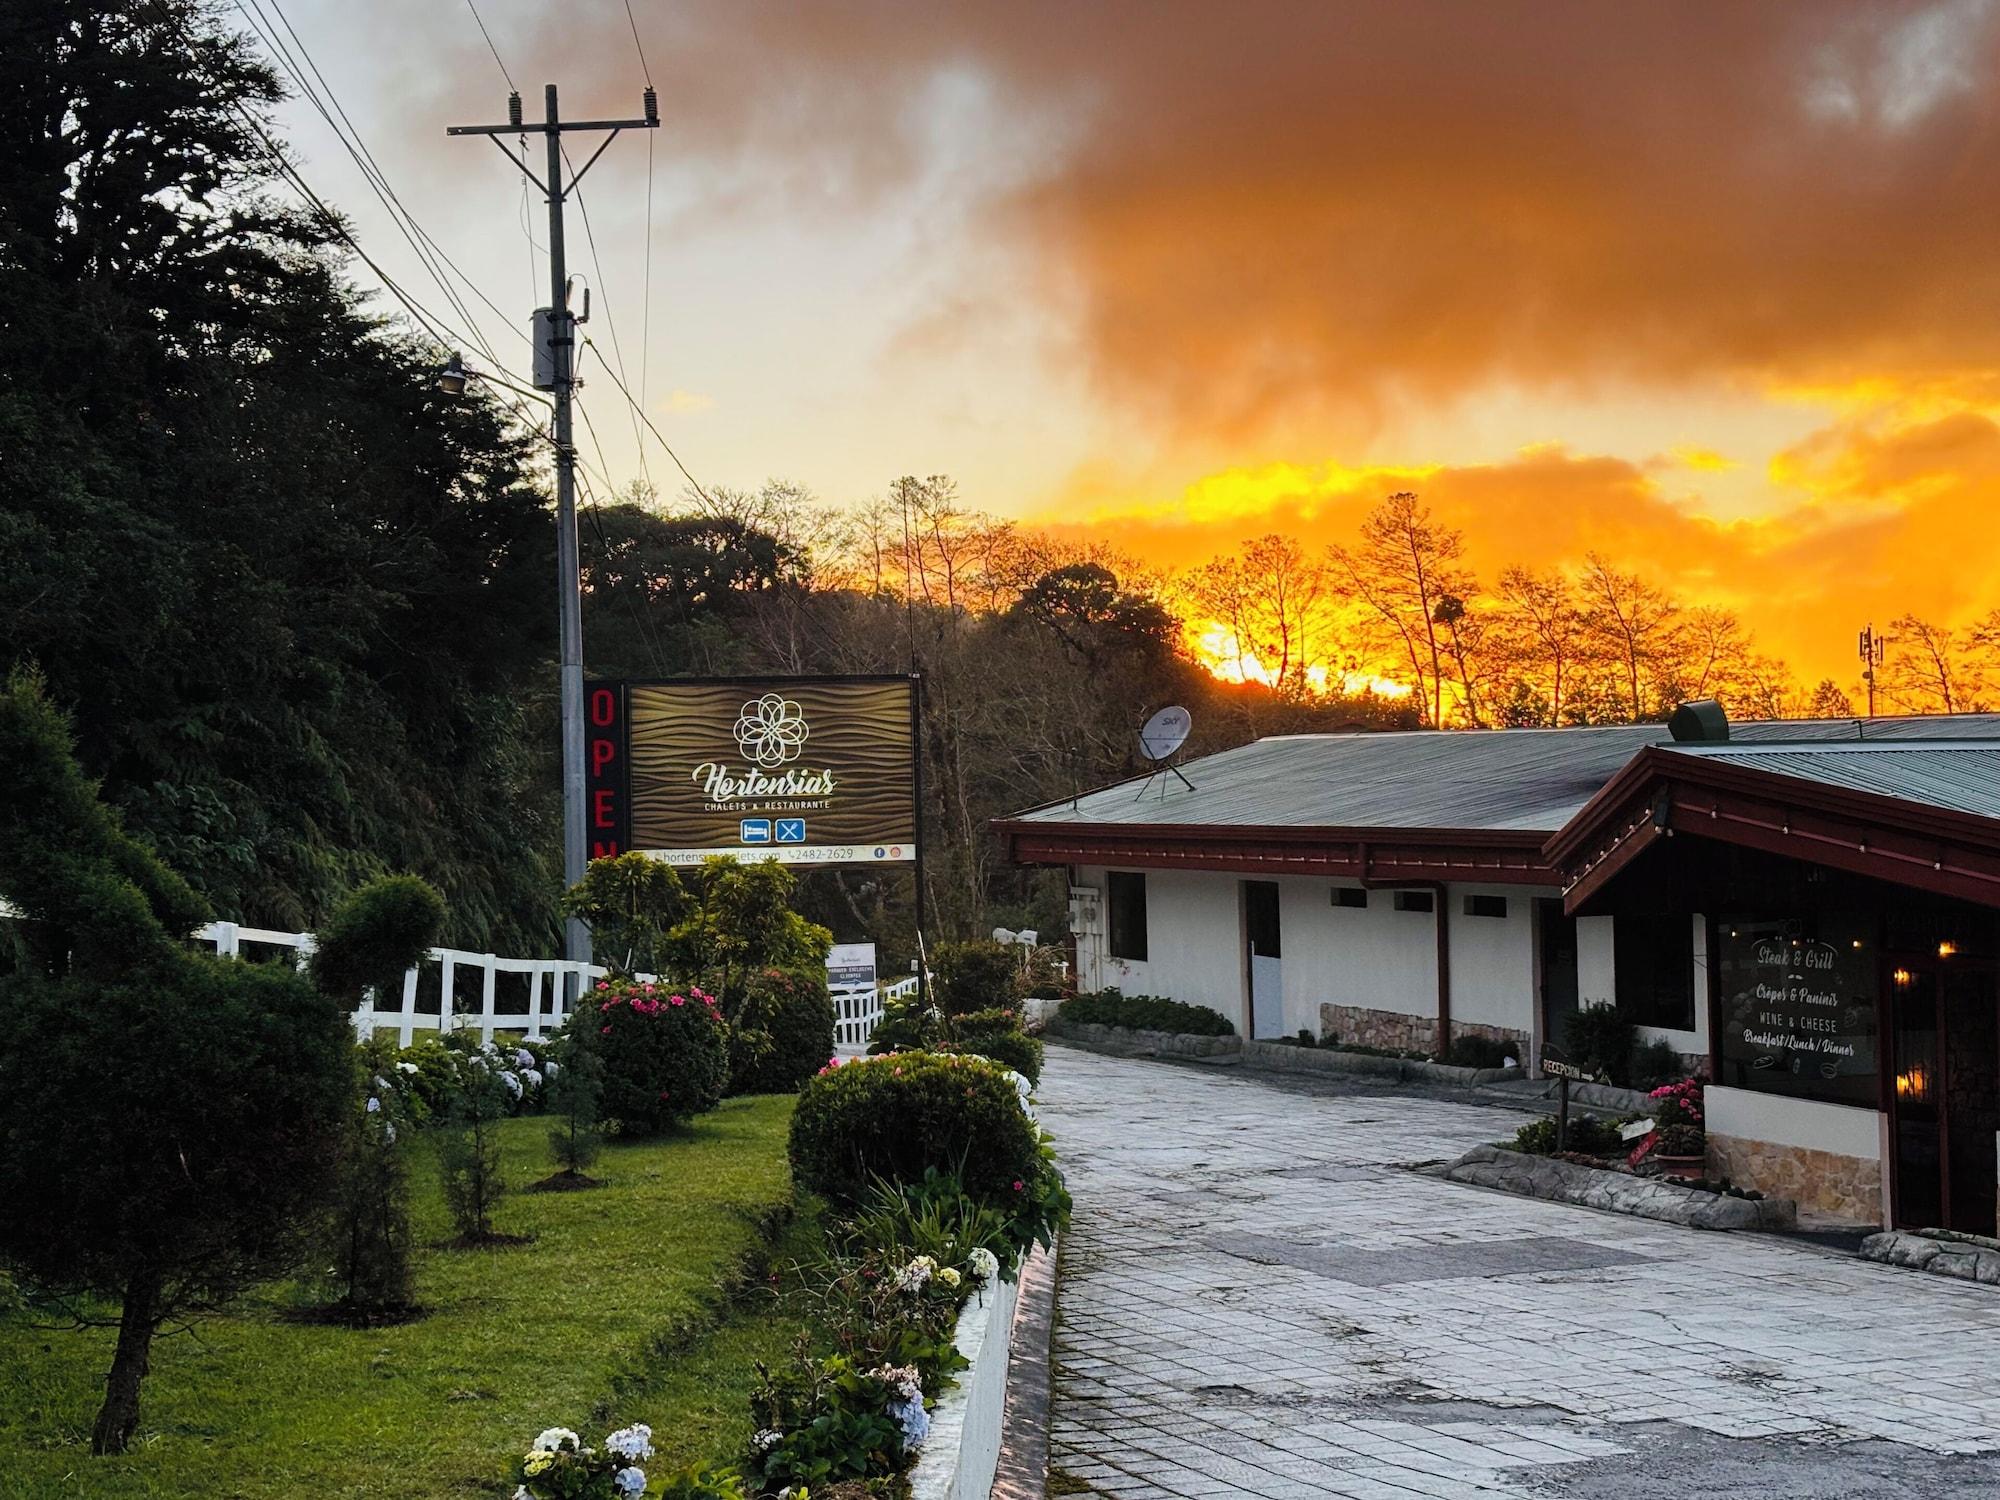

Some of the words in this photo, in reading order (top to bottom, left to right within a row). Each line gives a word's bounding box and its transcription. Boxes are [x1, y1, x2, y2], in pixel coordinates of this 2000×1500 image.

[1161, 716, 1181, 726] SKY
[691, 762, 838, 803] Hortensias
[704, 802, 747, 811] CHALETS
[765, 800, 831, 810] RESTAURANTE
[796, 848, 853, 860] 2482-2629
[1758, 946, 1790, 966] Steak
[1793, 950, 1802, 966] &
[1805, 950, 1834, 970] Grill
[1790, 988, 1798, 1001] &
[1760, 1011, 1783, 1026] WINE
[1789, 1017, 1795, 1027] &
[1801, 1016, 1837, 1033] CHEESE
